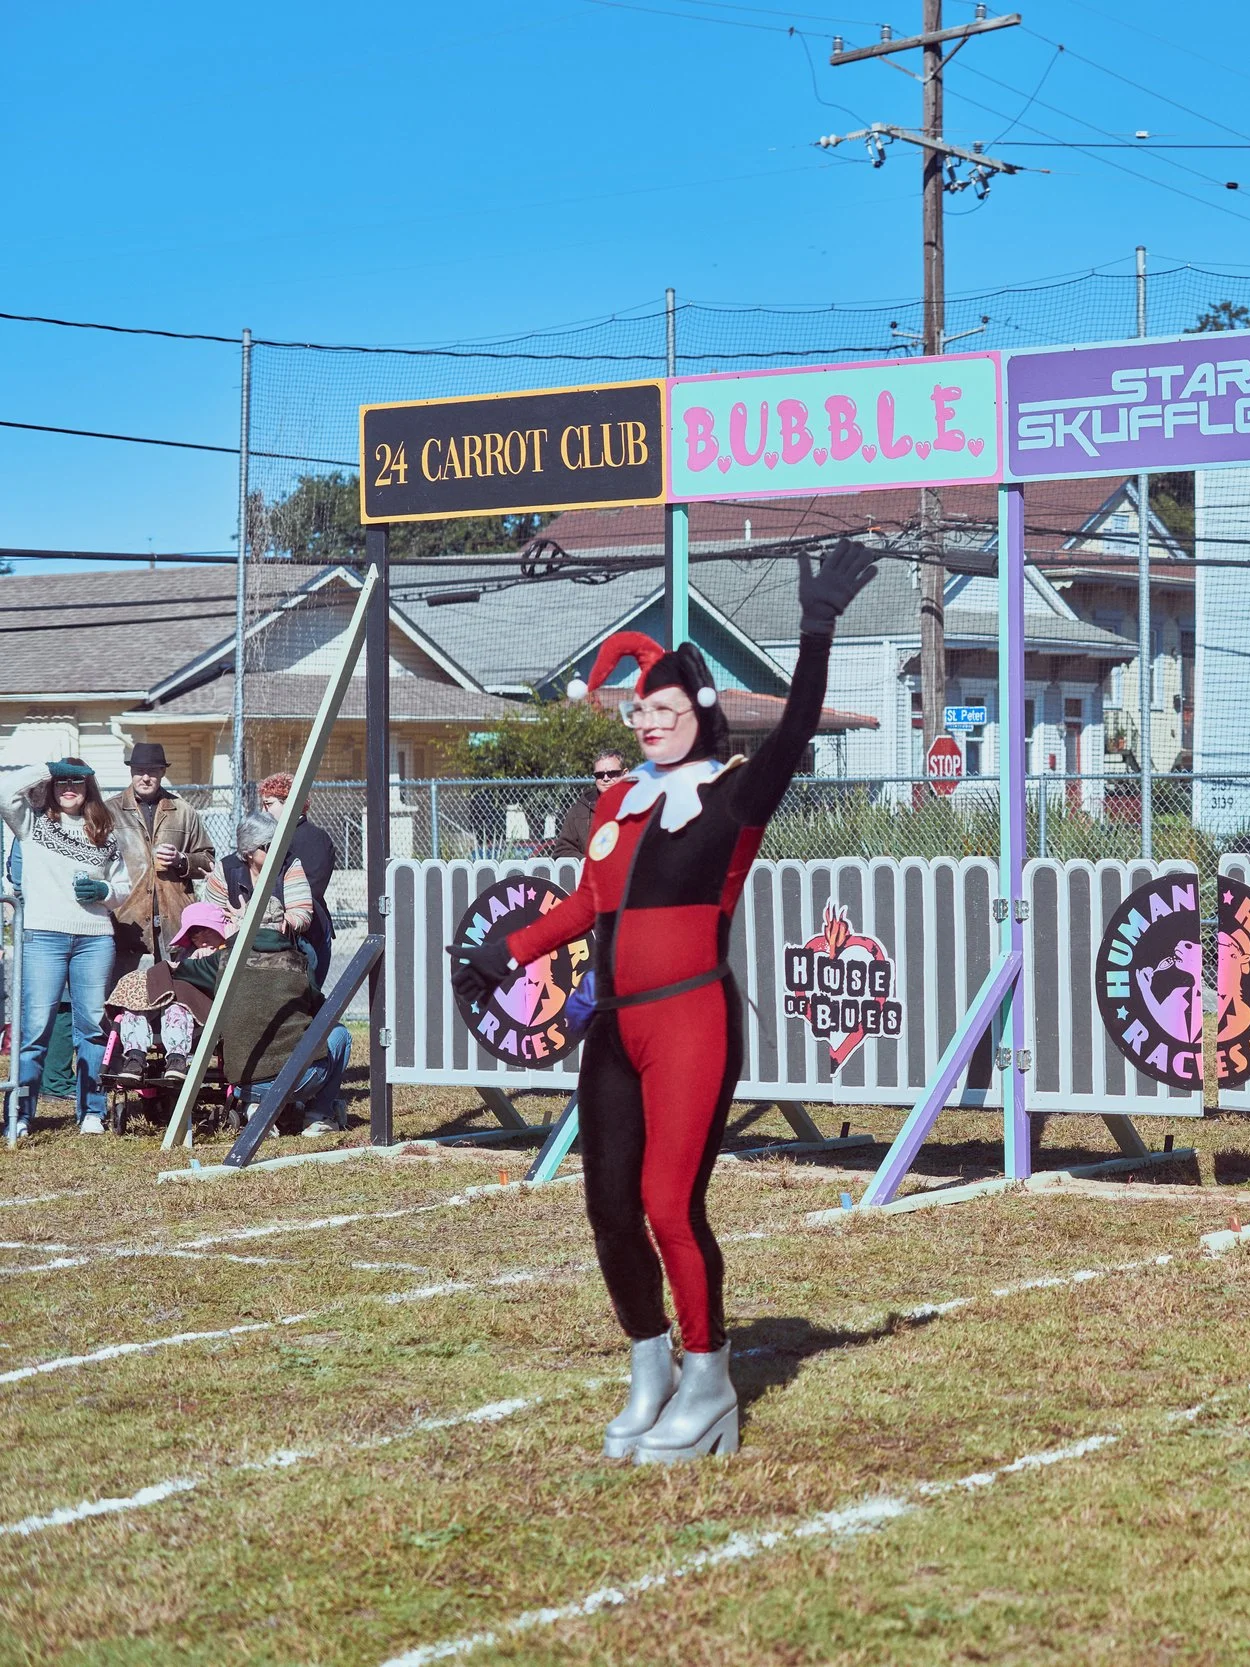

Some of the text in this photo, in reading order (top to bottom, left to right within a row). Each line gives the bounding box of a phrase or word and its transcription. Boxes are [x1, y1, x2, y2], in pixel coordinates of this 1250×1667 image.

[374, 420, 649, 487] 24 CARROT CLUB
[961, 709, 984, 721] Peter
[930, 755, 961, 777] STOP
[1211, 797, 1233, 809] 3139
[1106, 884, 1195, 998] HUMAN
[788, 1000, 806, 1013] OF
[477, 1010, 566, 1059] RACES
[1122, 1018, 1248, 1080] RACES
